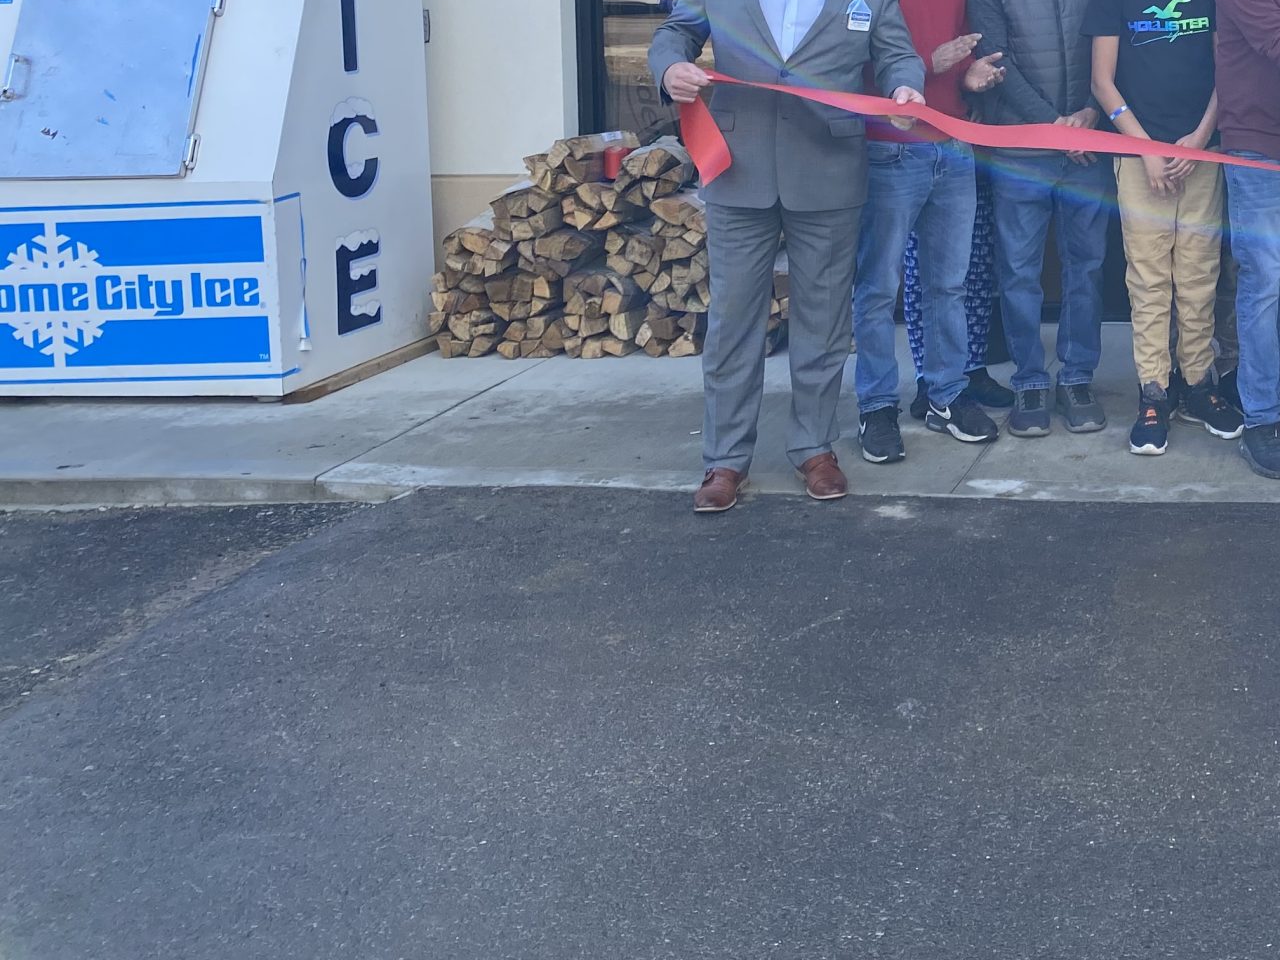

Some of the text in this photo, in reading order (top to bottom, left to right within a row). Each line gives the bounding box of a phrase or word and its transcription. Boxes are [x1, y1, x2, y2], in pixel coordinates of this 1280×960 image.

[0, 272, 260, 317] ome City Ice
